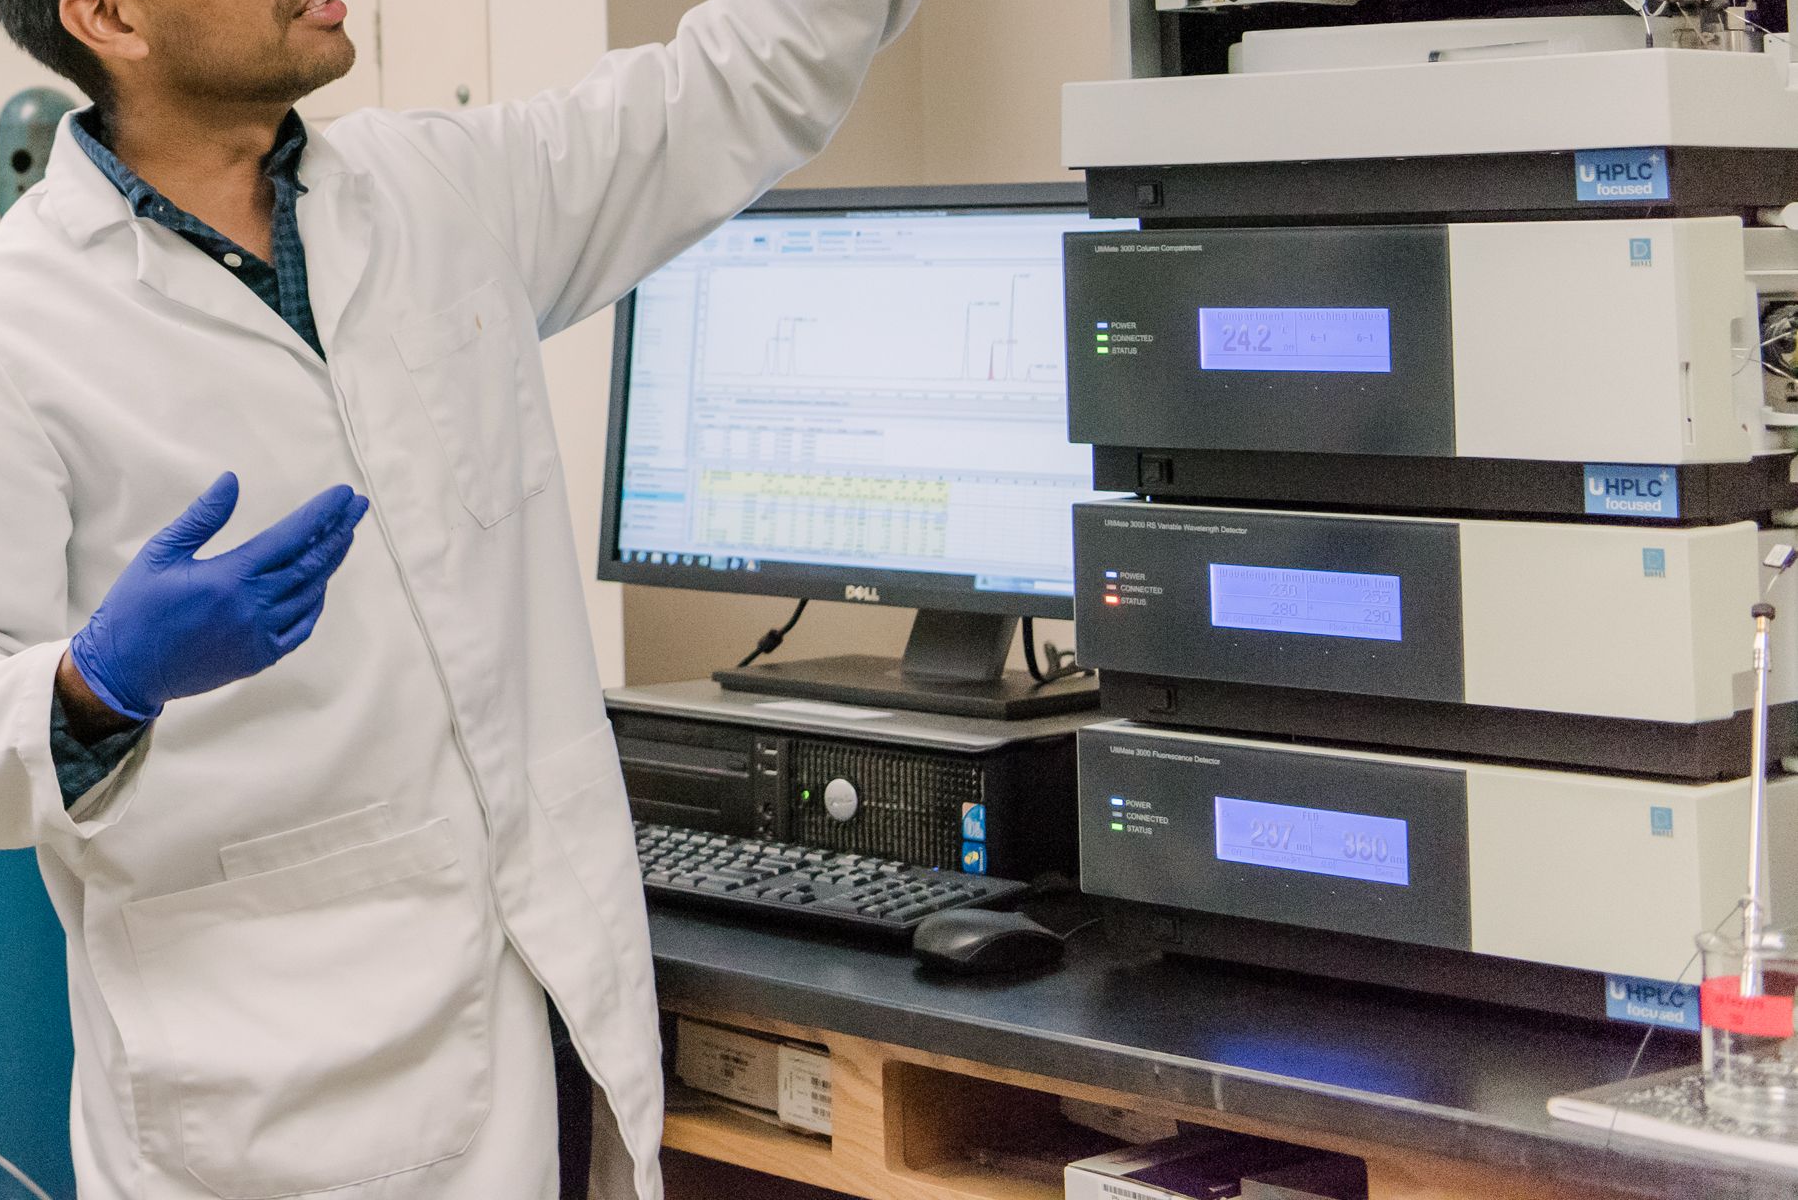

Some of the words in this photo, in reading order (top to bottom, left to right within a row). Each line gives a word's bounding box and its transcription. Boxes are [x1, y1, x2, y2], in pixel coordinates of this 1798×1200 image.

[1597, 182, 1652, 196] focused
[1136, 244, 1160, 252] Column
[1161, 244, 1202, 252] Compartment
[1111, 334, 1153, 342] CONNECTED
[1222, 322, 1272, 352] 24.2
[1112, 347, 1138, 355] STATUS
[1605, 497, 1661, 512] focused
[1130, 520, 1145, 529] 3000
[1146, 521, 1156, 529] RS
[1157, 522, 1183, 531] Variable
[1183, 523, 1220, 535] Wavelength
[1220, 526, 1248, 535] Detector
[1120, 571, 1145, 581] POWER
[845, 585, 880, 601] DELL
[1120, 584, 1163, 595] CONNECTED
[1121, 597, 1147, 606] STATUS
[1271, 602, 1298, 617] 280
[1363, 608, 1391, 624] 290
[1152, 750, 1193, 762] Fluorescence
[1194, 755, 1220, 765] Detector
[1126, 799, 1152, 809] POWER
[1126, 812, 1169, 825] CONNECTED
[1126, 825, 1153, 835] STATUS
[1250, 817, 1295, 851] 237
[1626, 1002, 1685, 1024] focused
